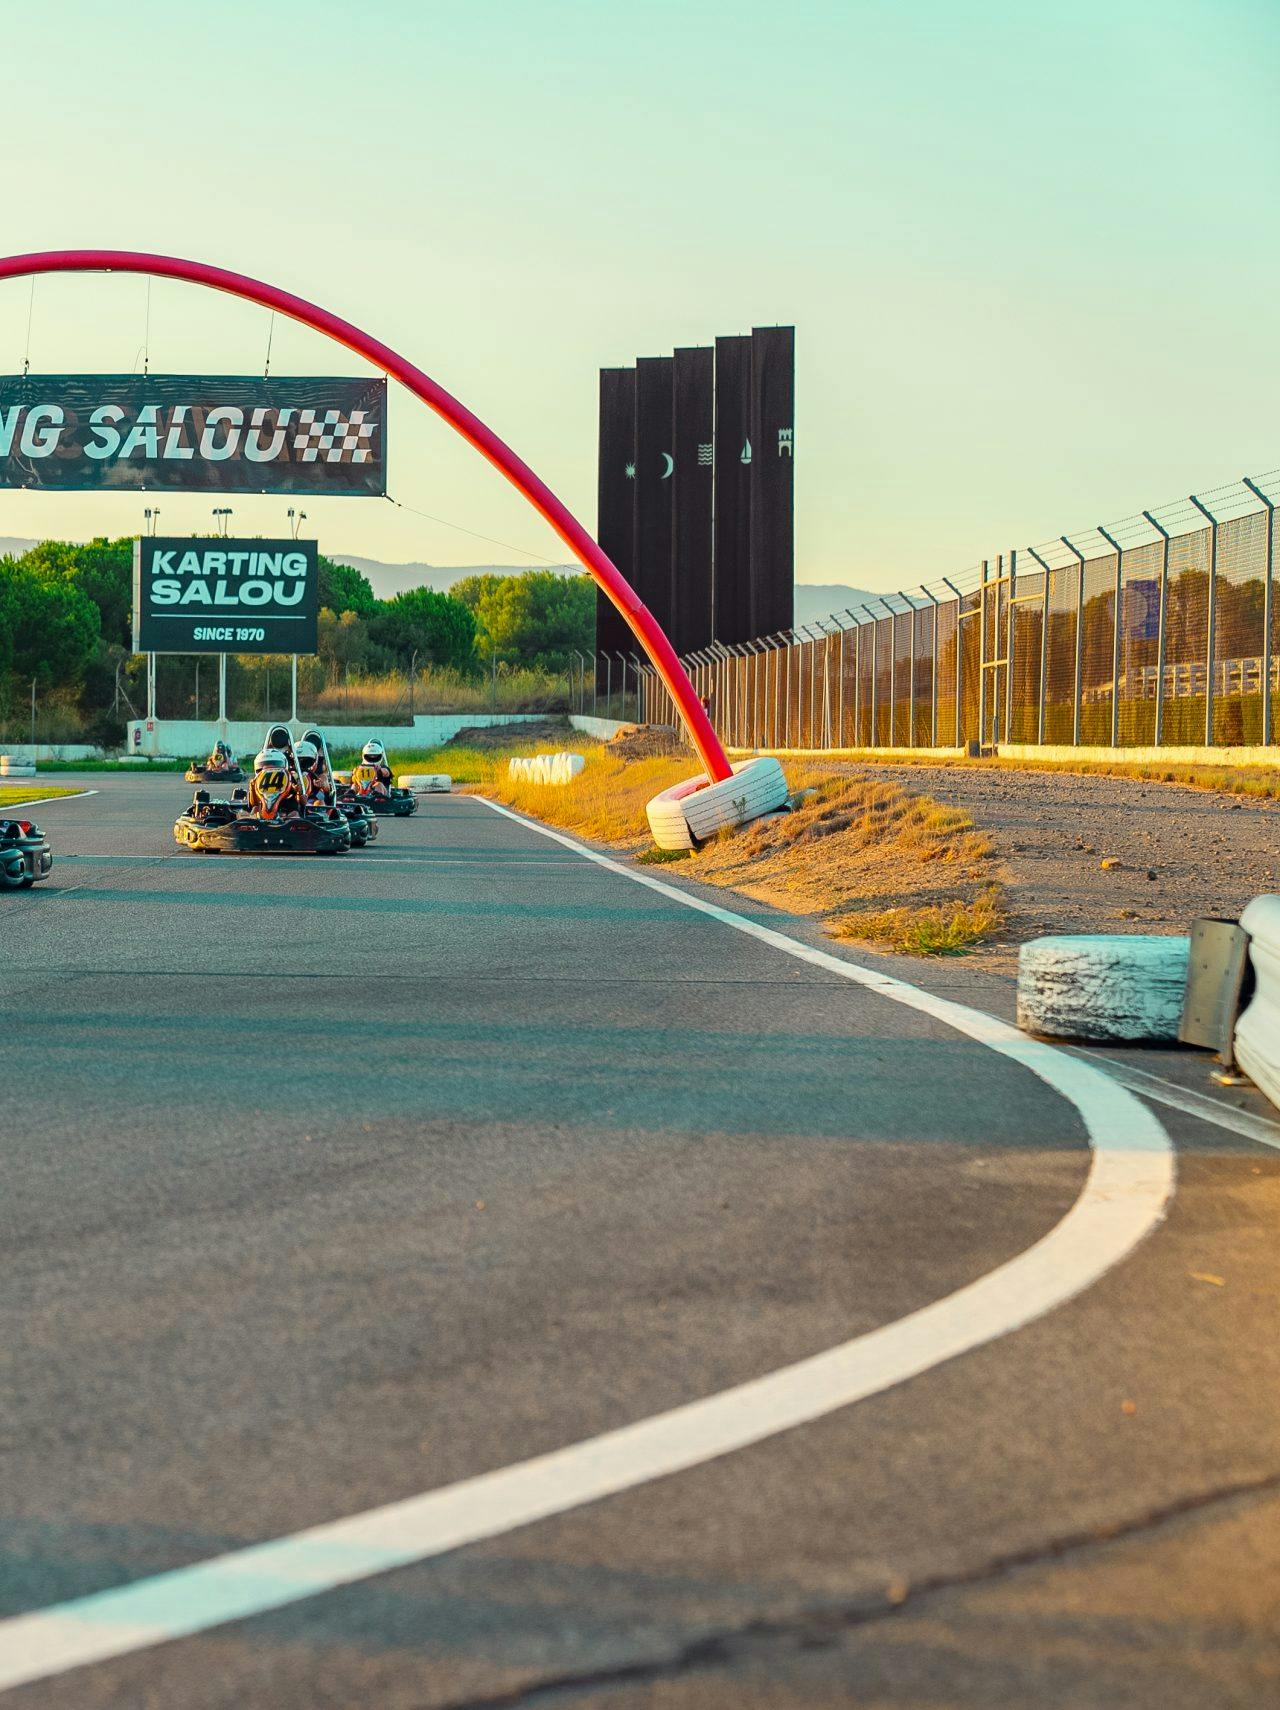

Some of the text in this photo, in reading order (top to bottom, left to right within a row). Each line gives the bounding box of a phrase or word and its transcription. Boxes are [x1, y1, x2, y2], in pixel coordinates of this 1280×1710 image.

[83, 405, 298, 462] SALOU
[151, 550, 307, 577] KARTING
[150, 579, 306, 606] SALOU
[193, 627, 265, 641] SINCE 1970
[259, 771, 285, 791] 44
[361, 769, 370, 778] 11
